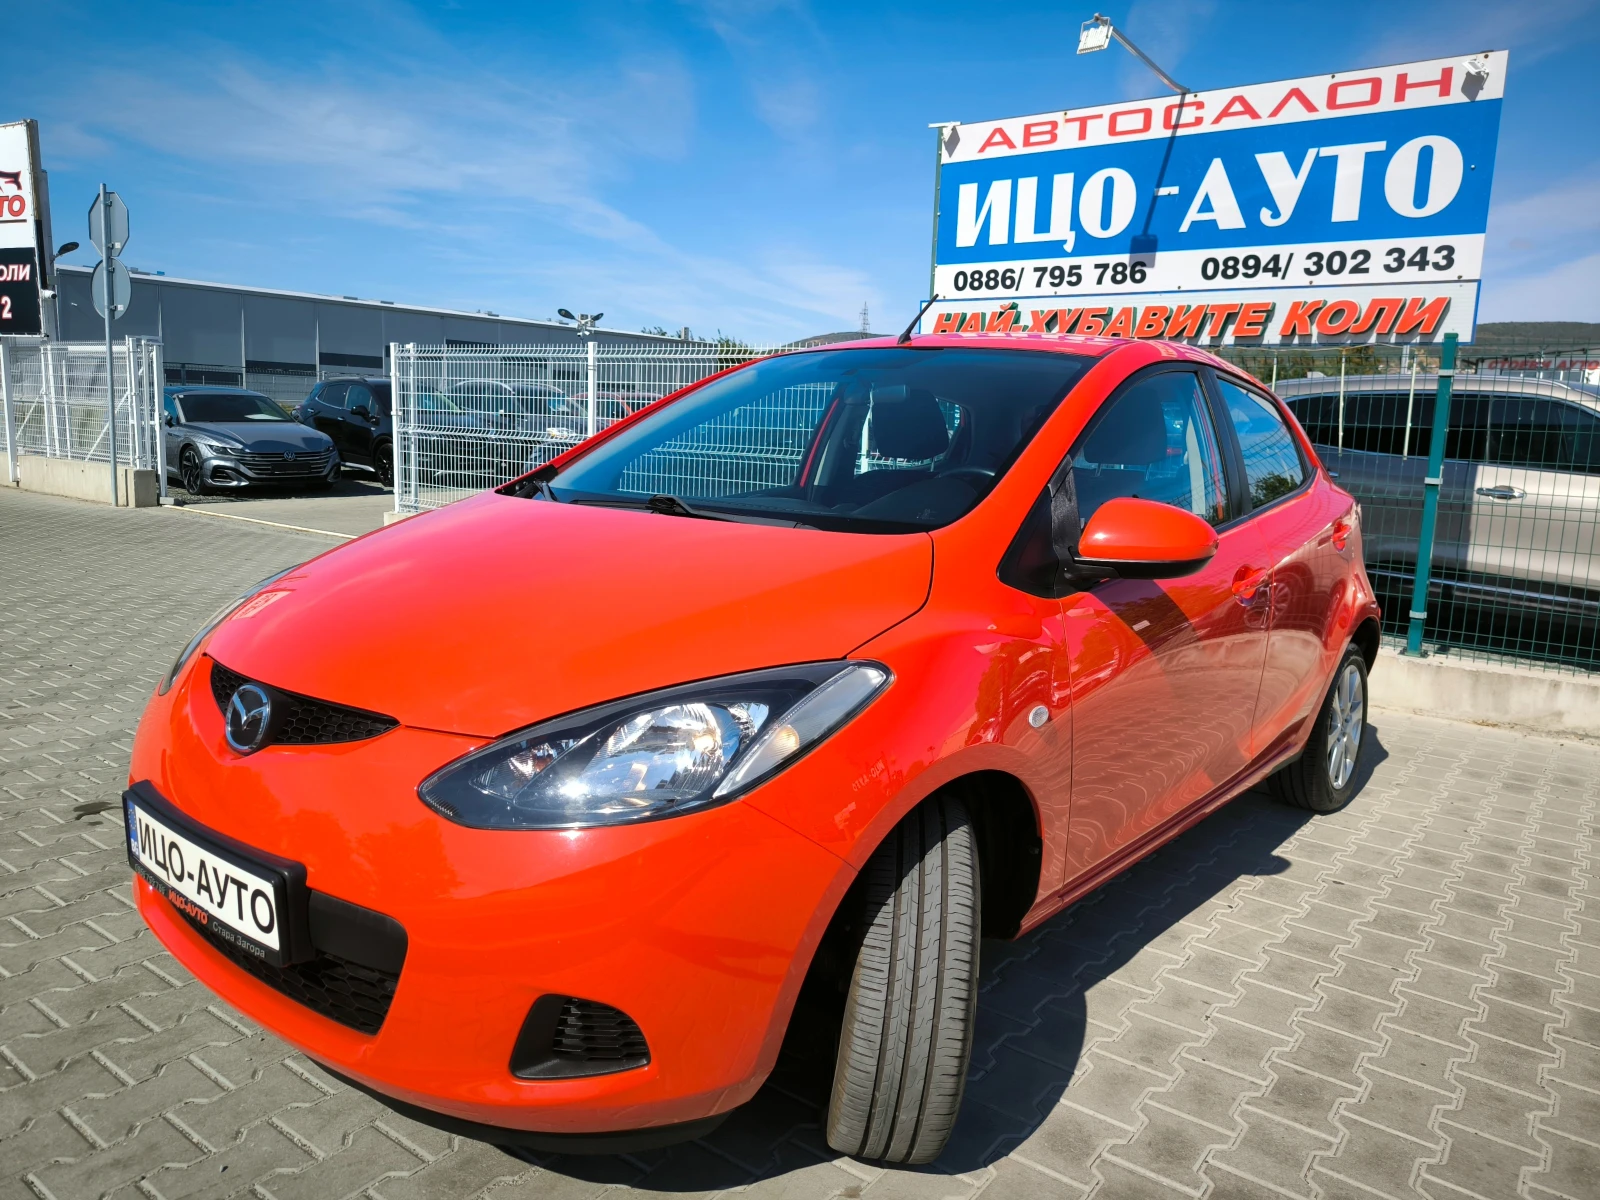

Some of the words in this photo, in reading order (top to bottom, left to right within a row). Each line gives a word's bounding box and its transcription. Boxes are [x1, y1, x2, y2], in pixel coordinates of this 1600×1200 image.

[977, 66, 1453, 153] АВТОСАЛОН
[952, 268, 1023, 293] 0886/
[1032, 264, 1083, 289] 795
[1093, 260, 1147, 286] 786
[1200, 254, 1294, 282] 0894/
[1302, 248, 1371, 277] 302
[1382, 244, 1456, 273] 343
[932, 301, 1275, 338] НАЙ-ХУБАВИТЕ
[1279, 296, 1452, 336] КОЛИ
[138, 817, 275, 935] ИЦО-АУТО
[212, 921, 235, 942] Стара
[236, 935, 265, 958] Загора
